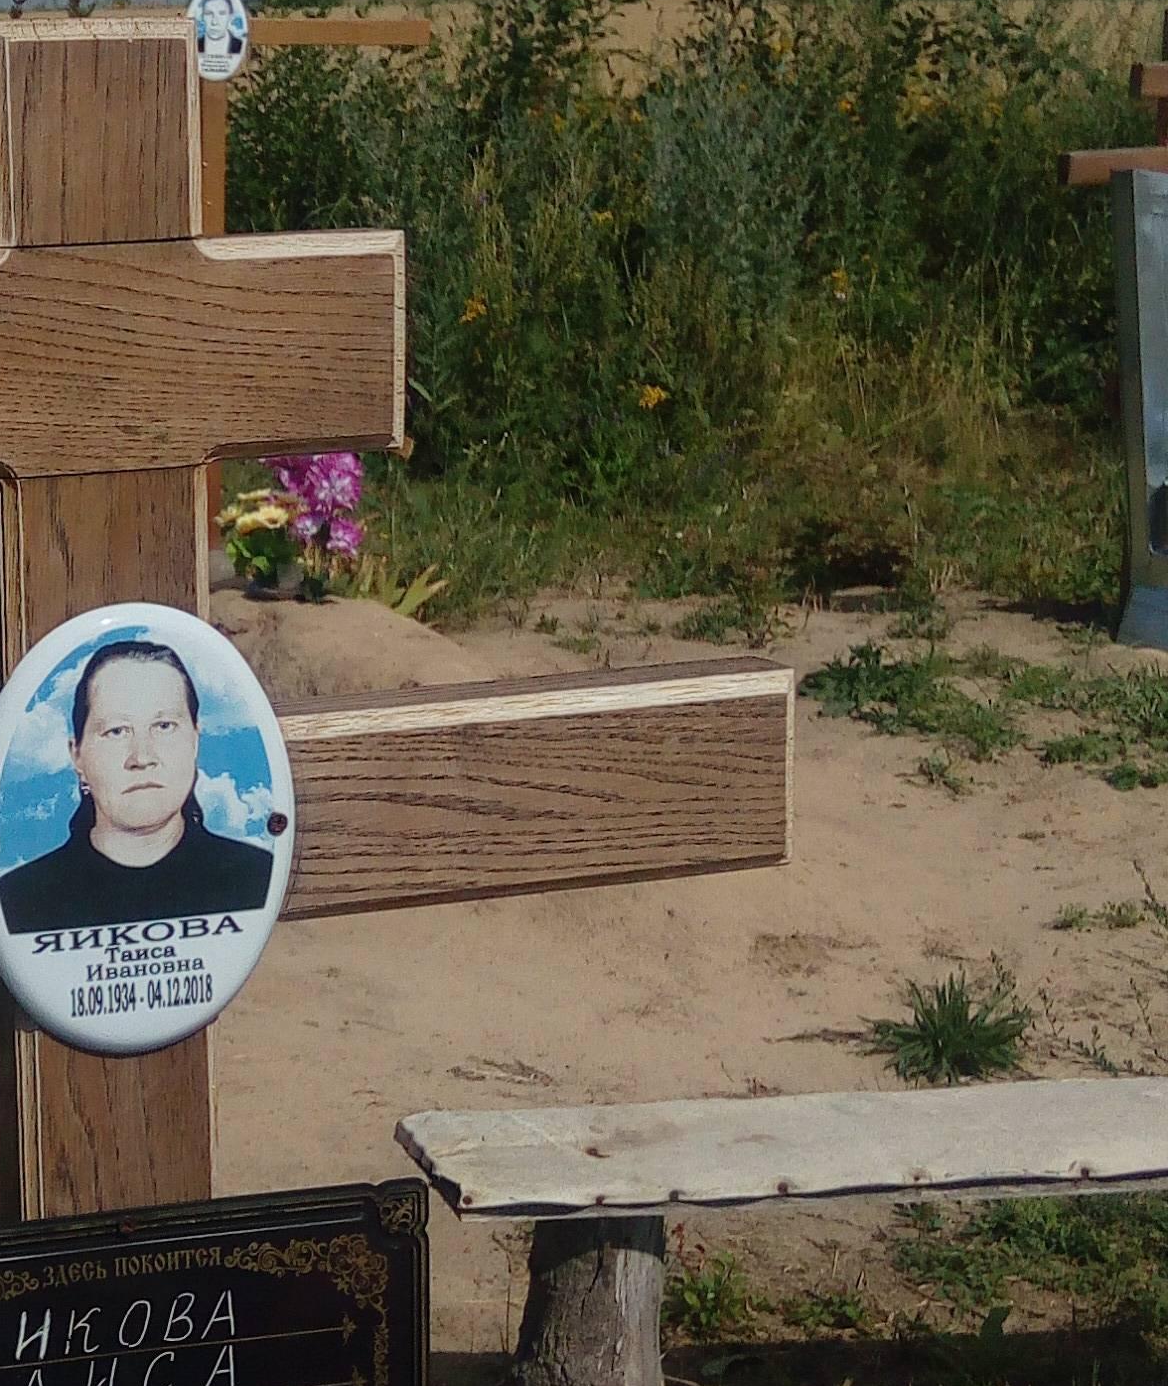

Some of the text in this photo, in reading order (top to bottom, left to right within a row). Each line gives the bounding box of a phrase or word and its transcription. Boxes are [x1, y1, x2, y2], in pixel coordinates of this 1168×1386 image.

[32, 915, 243, 954] ЯИКОВА
[104, 944, 176, 963] Таиса
[86, 957, 204, 982] Ивановна
[70, 982, 136, 1017] 18.09.1934
[147, 974, 212, 1009] 04.12.2018
[43, 1246, 223, 1288] ЗДЕСЬ ПОКОИТСЯ
